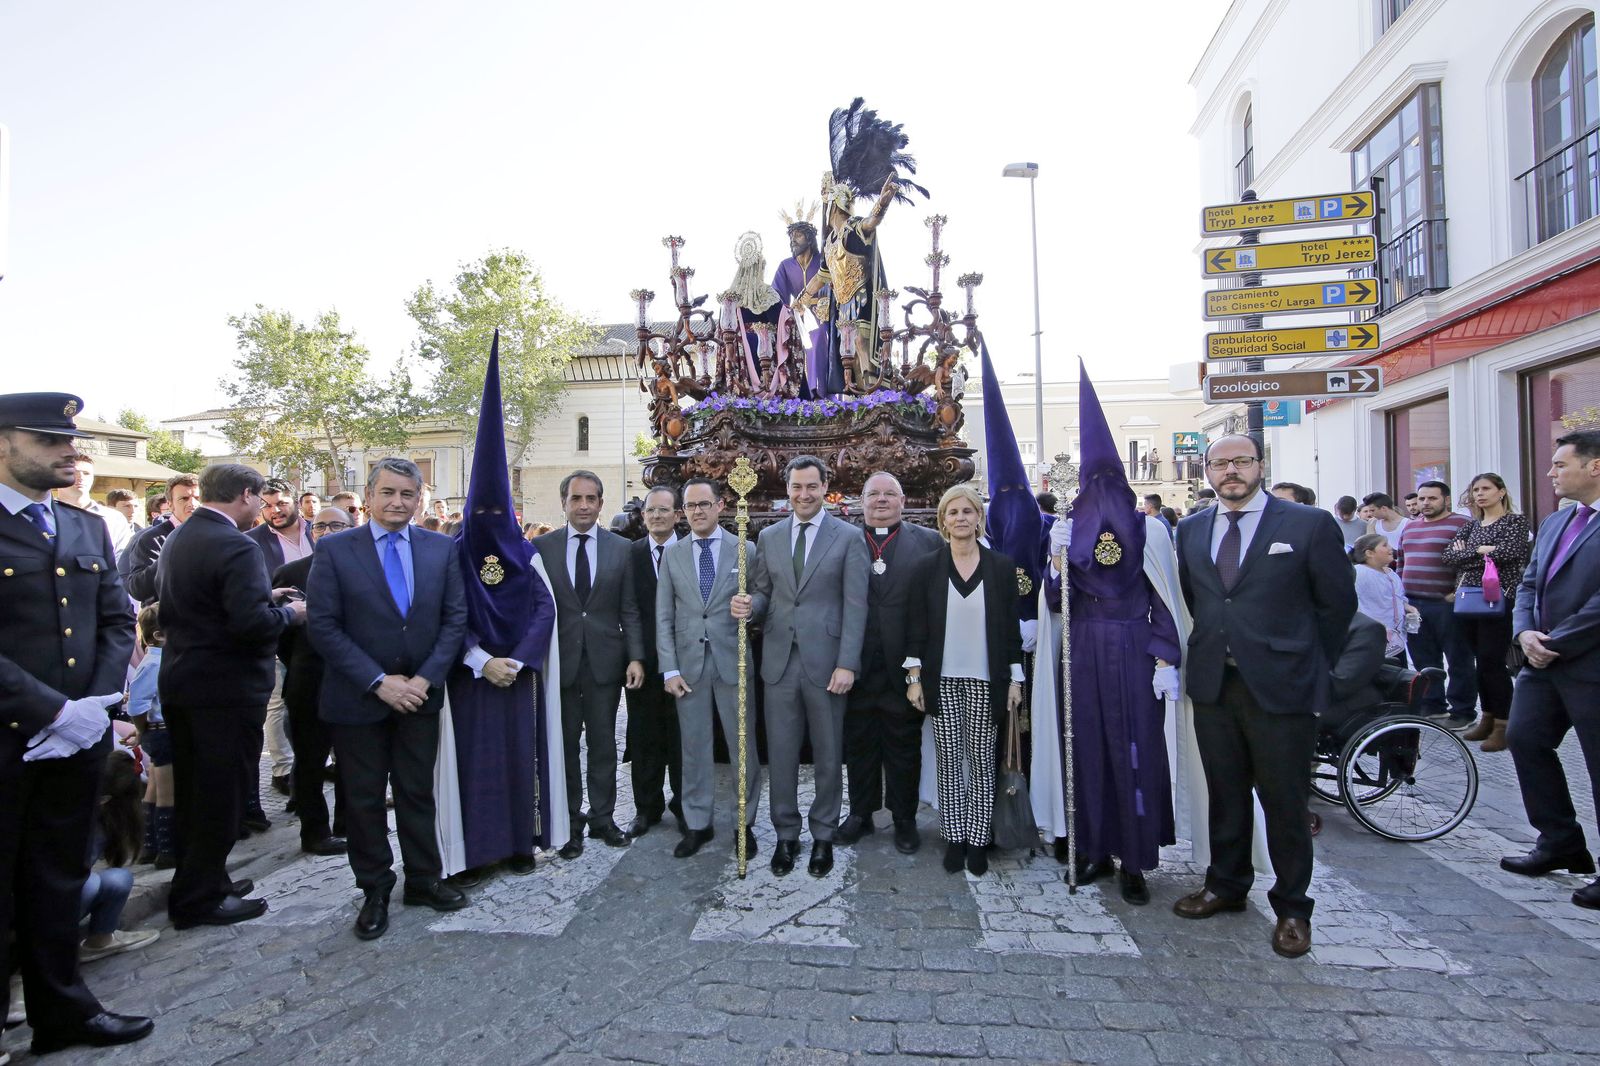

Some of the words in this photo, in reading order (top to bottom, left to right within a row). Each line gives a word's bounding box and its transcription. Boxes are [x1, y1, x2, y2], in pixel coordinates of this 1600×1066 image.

[1208, 208, 1234, 217] hotel
[1209, 218, 1236, 228] Tryp
[1241, 213, 1275, 225] Jerez
[1301, 242, 1328, 252] hotel
[1301, 252, 1330, 263] Tryp
[1335, 248, 1371, 260] Jerez
[1210, 289, 1280, 302] aparcamiento
[1210, 304, 1228, 312] Los
[1287, 297, 1316, 307] Larga
[1212, 333, 1278, 346] ambulatorio
[1212, 343, 1268, 356] Seguridad
[1272, 341, 1306, 352] Social
[1213, 380, 1280, 394] zoológico
